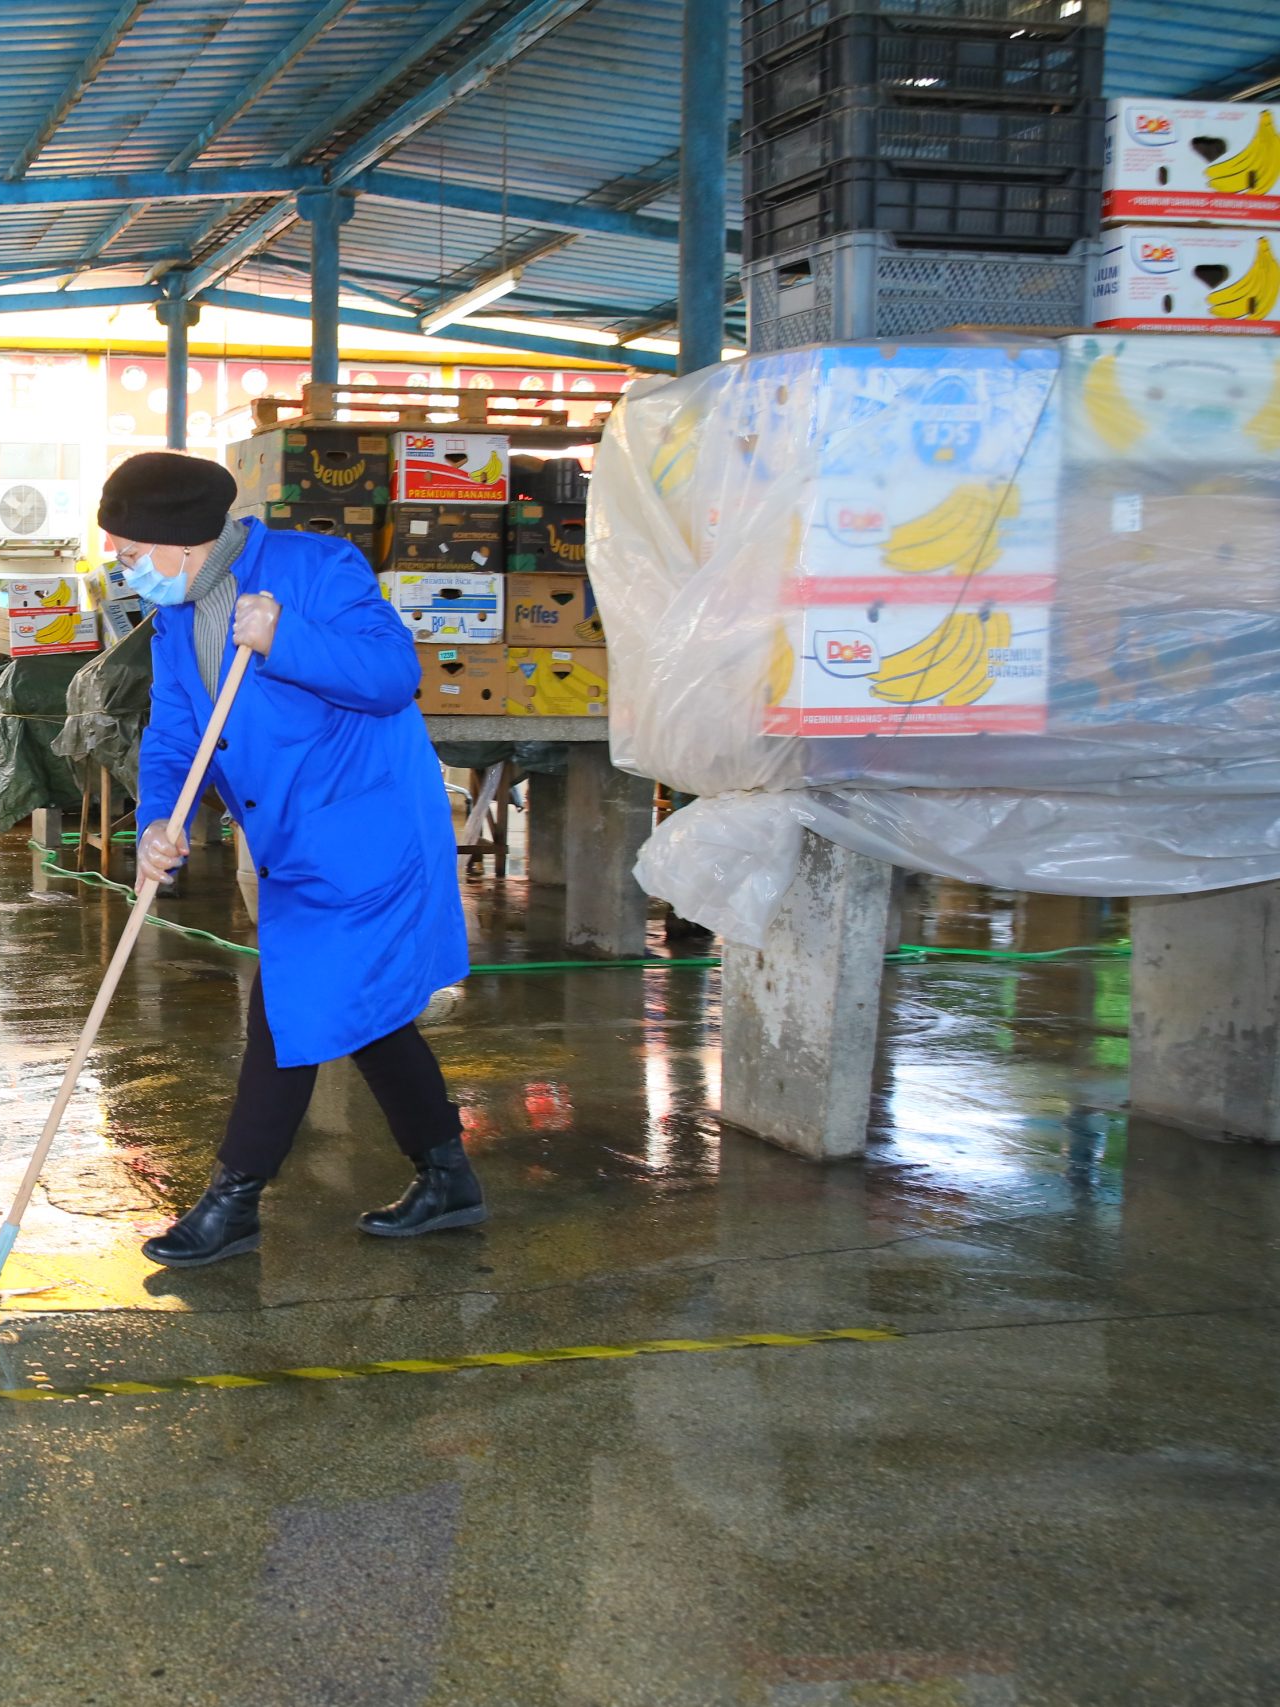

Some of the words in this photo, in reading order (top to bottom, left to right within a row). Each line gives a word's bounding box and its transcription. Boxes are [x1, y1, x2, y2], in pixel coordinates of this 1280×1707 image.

[1136, 114, 1172, 132] Dole
[1141, 244, 1175, 261] Dole
[406, 435, 434, 449] Dole
[408, 489, 455, 499] PREMIUM
[457, 490, 503, 500] BANANAS
[838, 508, 884, 531] Dole
[431, 616, 468, 634] BOA
[827, 640, 872, 662] Dole
[987, 647, 1042, 662] PREMIUM
[987, 665, 1042, 679] BANANAS
[803, 714, 842, 724] PREMIUM
